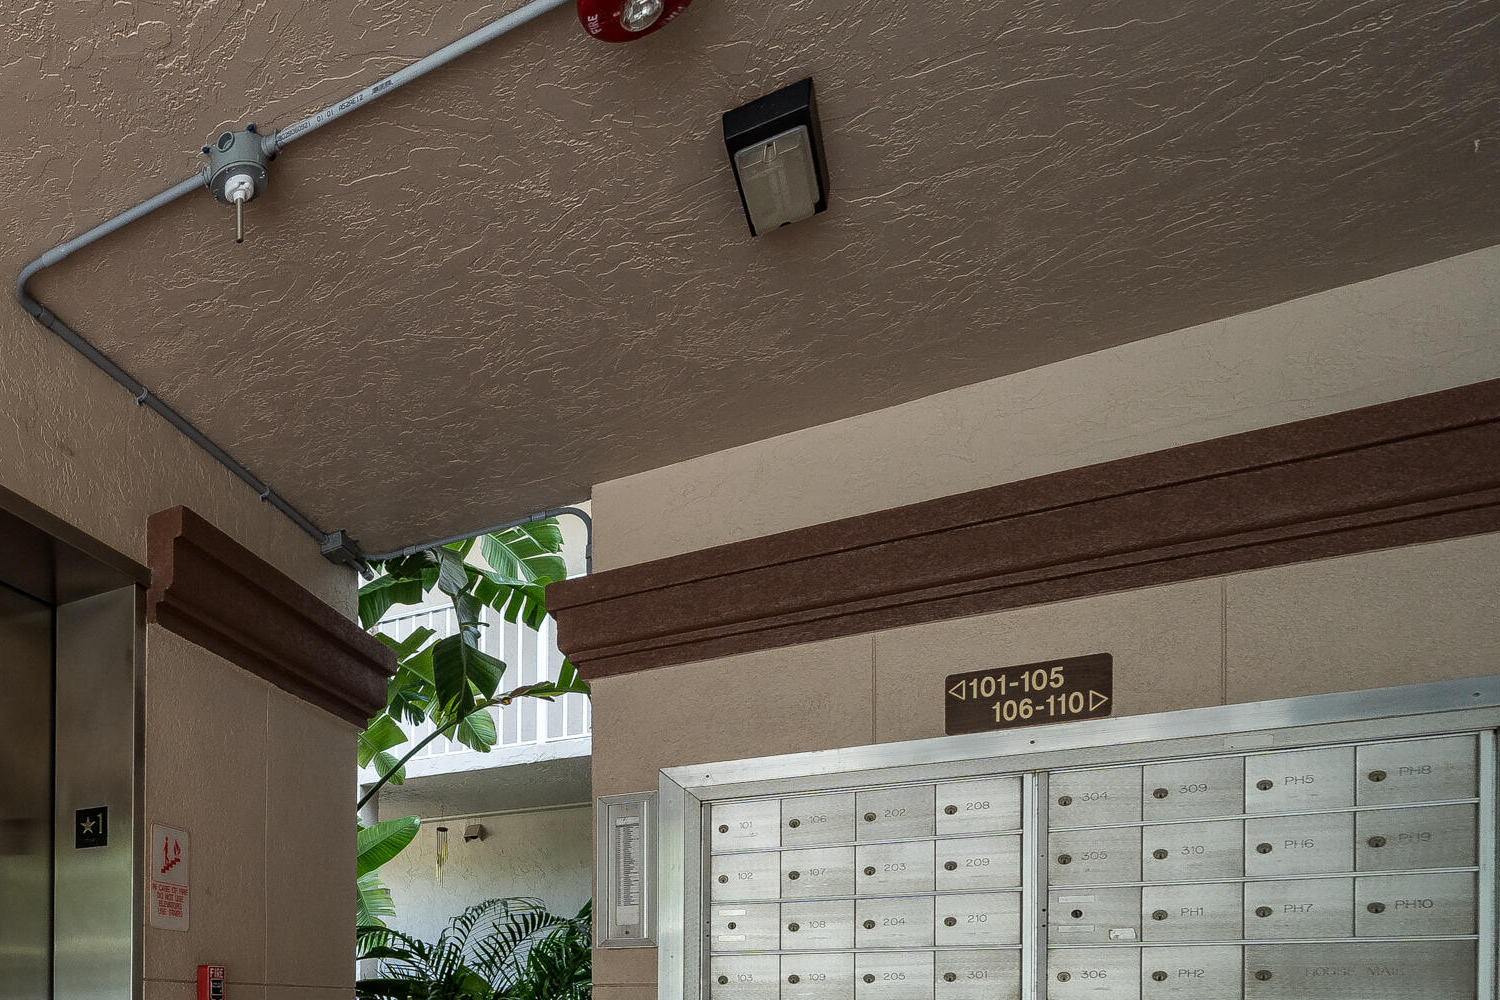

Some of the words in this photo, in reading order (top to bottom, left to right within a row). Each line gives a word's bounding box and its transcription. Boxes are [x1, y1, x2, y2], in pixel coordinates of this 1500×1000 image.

[587, 14, 602, 35] FIRE
[969, 666, 1065, 699] 101-105
[992, 691, 1084, 723] 106-110
[1399, 765, 1432, 777] PH8
[1284, 775, 1314, 785] PH5
[1179, 784, 1208, 794] 309
[1081, 791, 1108, 801] 304
[966, 801, 990, 811] 208
[884, 809, 906, 818] 202
[97, 813, 103, 834] 1
[810, 815, 827, 824] 106
[1284, 839, 1314, 849] PH6
[1181, 845, 1205, 855] 310
[1081, 851, 1108, 861] 305
[884, 863, 906, 872] 203
[965, 858, 990, 867] 209
[738, 872, 753, 880] 102
[809, 868, 826, 876] 107
[159, 884, 170, 893] CASE
[158, 900, 182, 910] ELEVATORS
[1283, 904, 1314, 914] PH7
[1395, 899, 1434, 909] PH10
[169, 909, 183, 917] STAIRS
[1180, 907, 1204, 917] PH1
[883, 918, 905, 926] 204
[967, 914, 987, 923] 210
[809, 920, 826, 928] 108
[210, 968, 224, 978] FIRE
[737, 974, 753, 982] 103
[883, 972, 906, 981] 205
[967, 971, 988, 979] 301
[1081, 970, 1107, 979] 306
[1178, 969, 1205, 978] PH2
